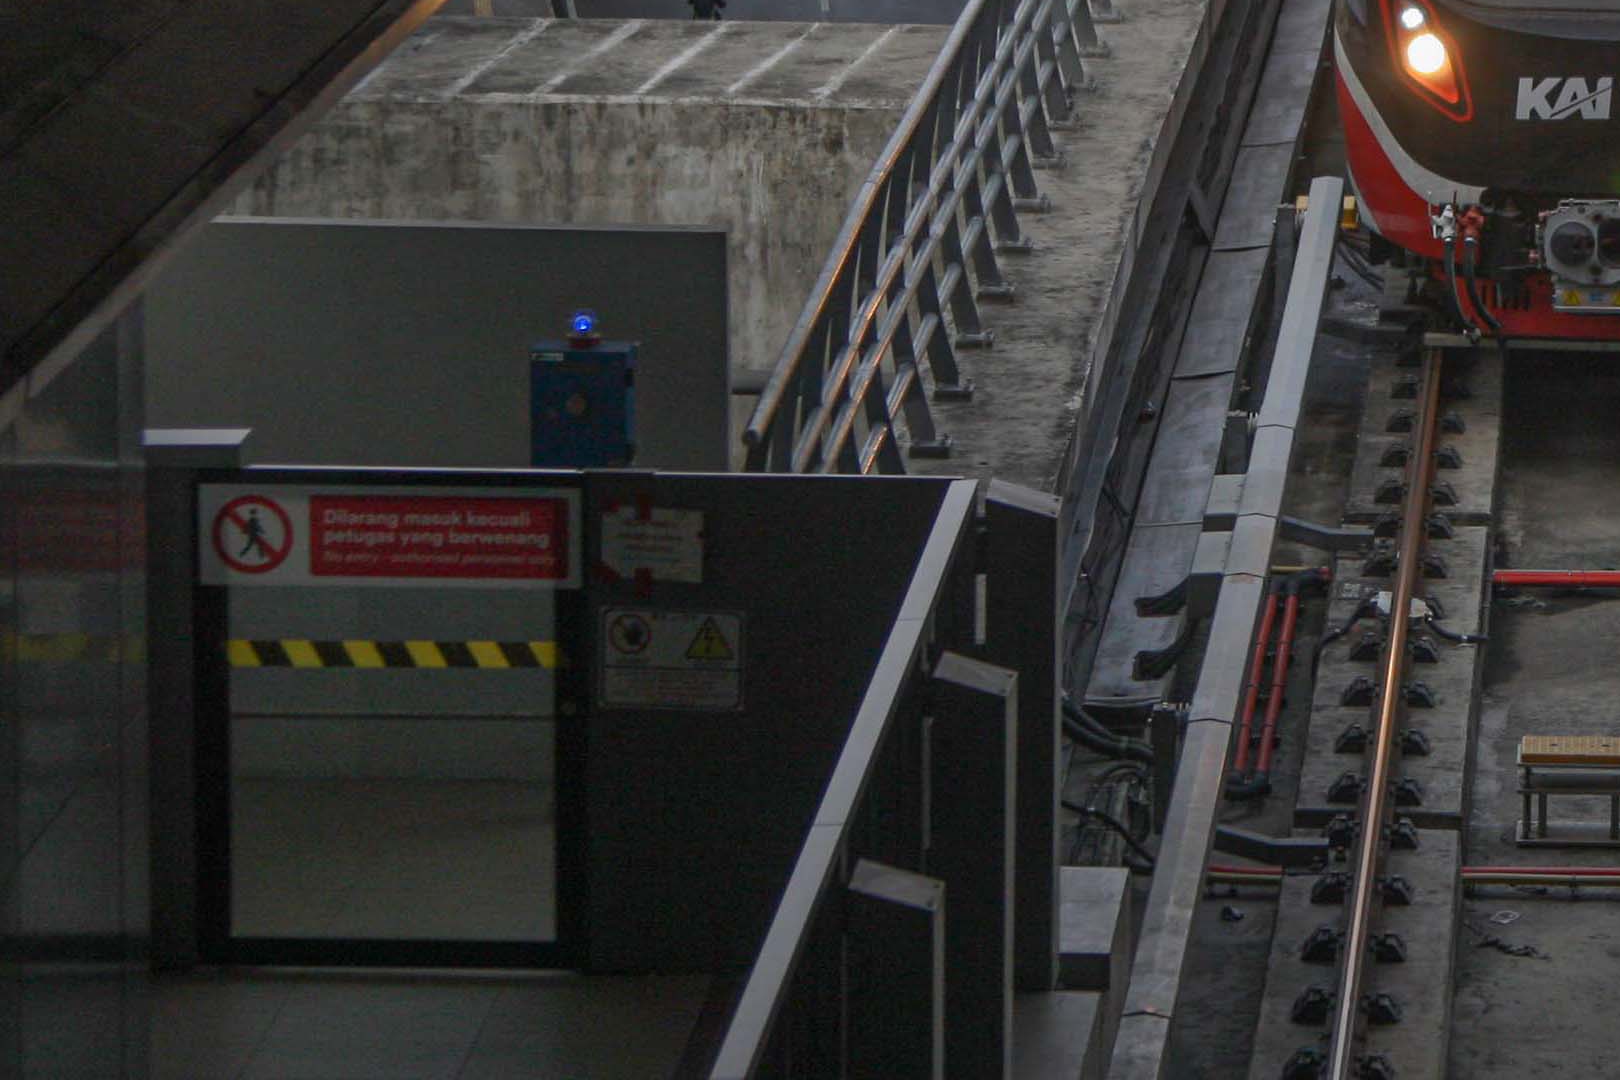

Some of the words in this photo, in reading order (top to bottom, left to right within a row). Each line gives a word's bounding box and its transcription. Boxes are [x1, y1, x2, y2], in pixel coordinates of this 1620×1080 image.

[1515, 76, 1613, 121] KAI
[323, 508, 398, 528] Dilarang
[403, 510, 462, 526] masuk
[467, 510, 531, 527] kecuali
[323, 529, 395, 547] petugas
[400, 531, 444, 548] yang
[448, 529, 550, 549] berwenang
